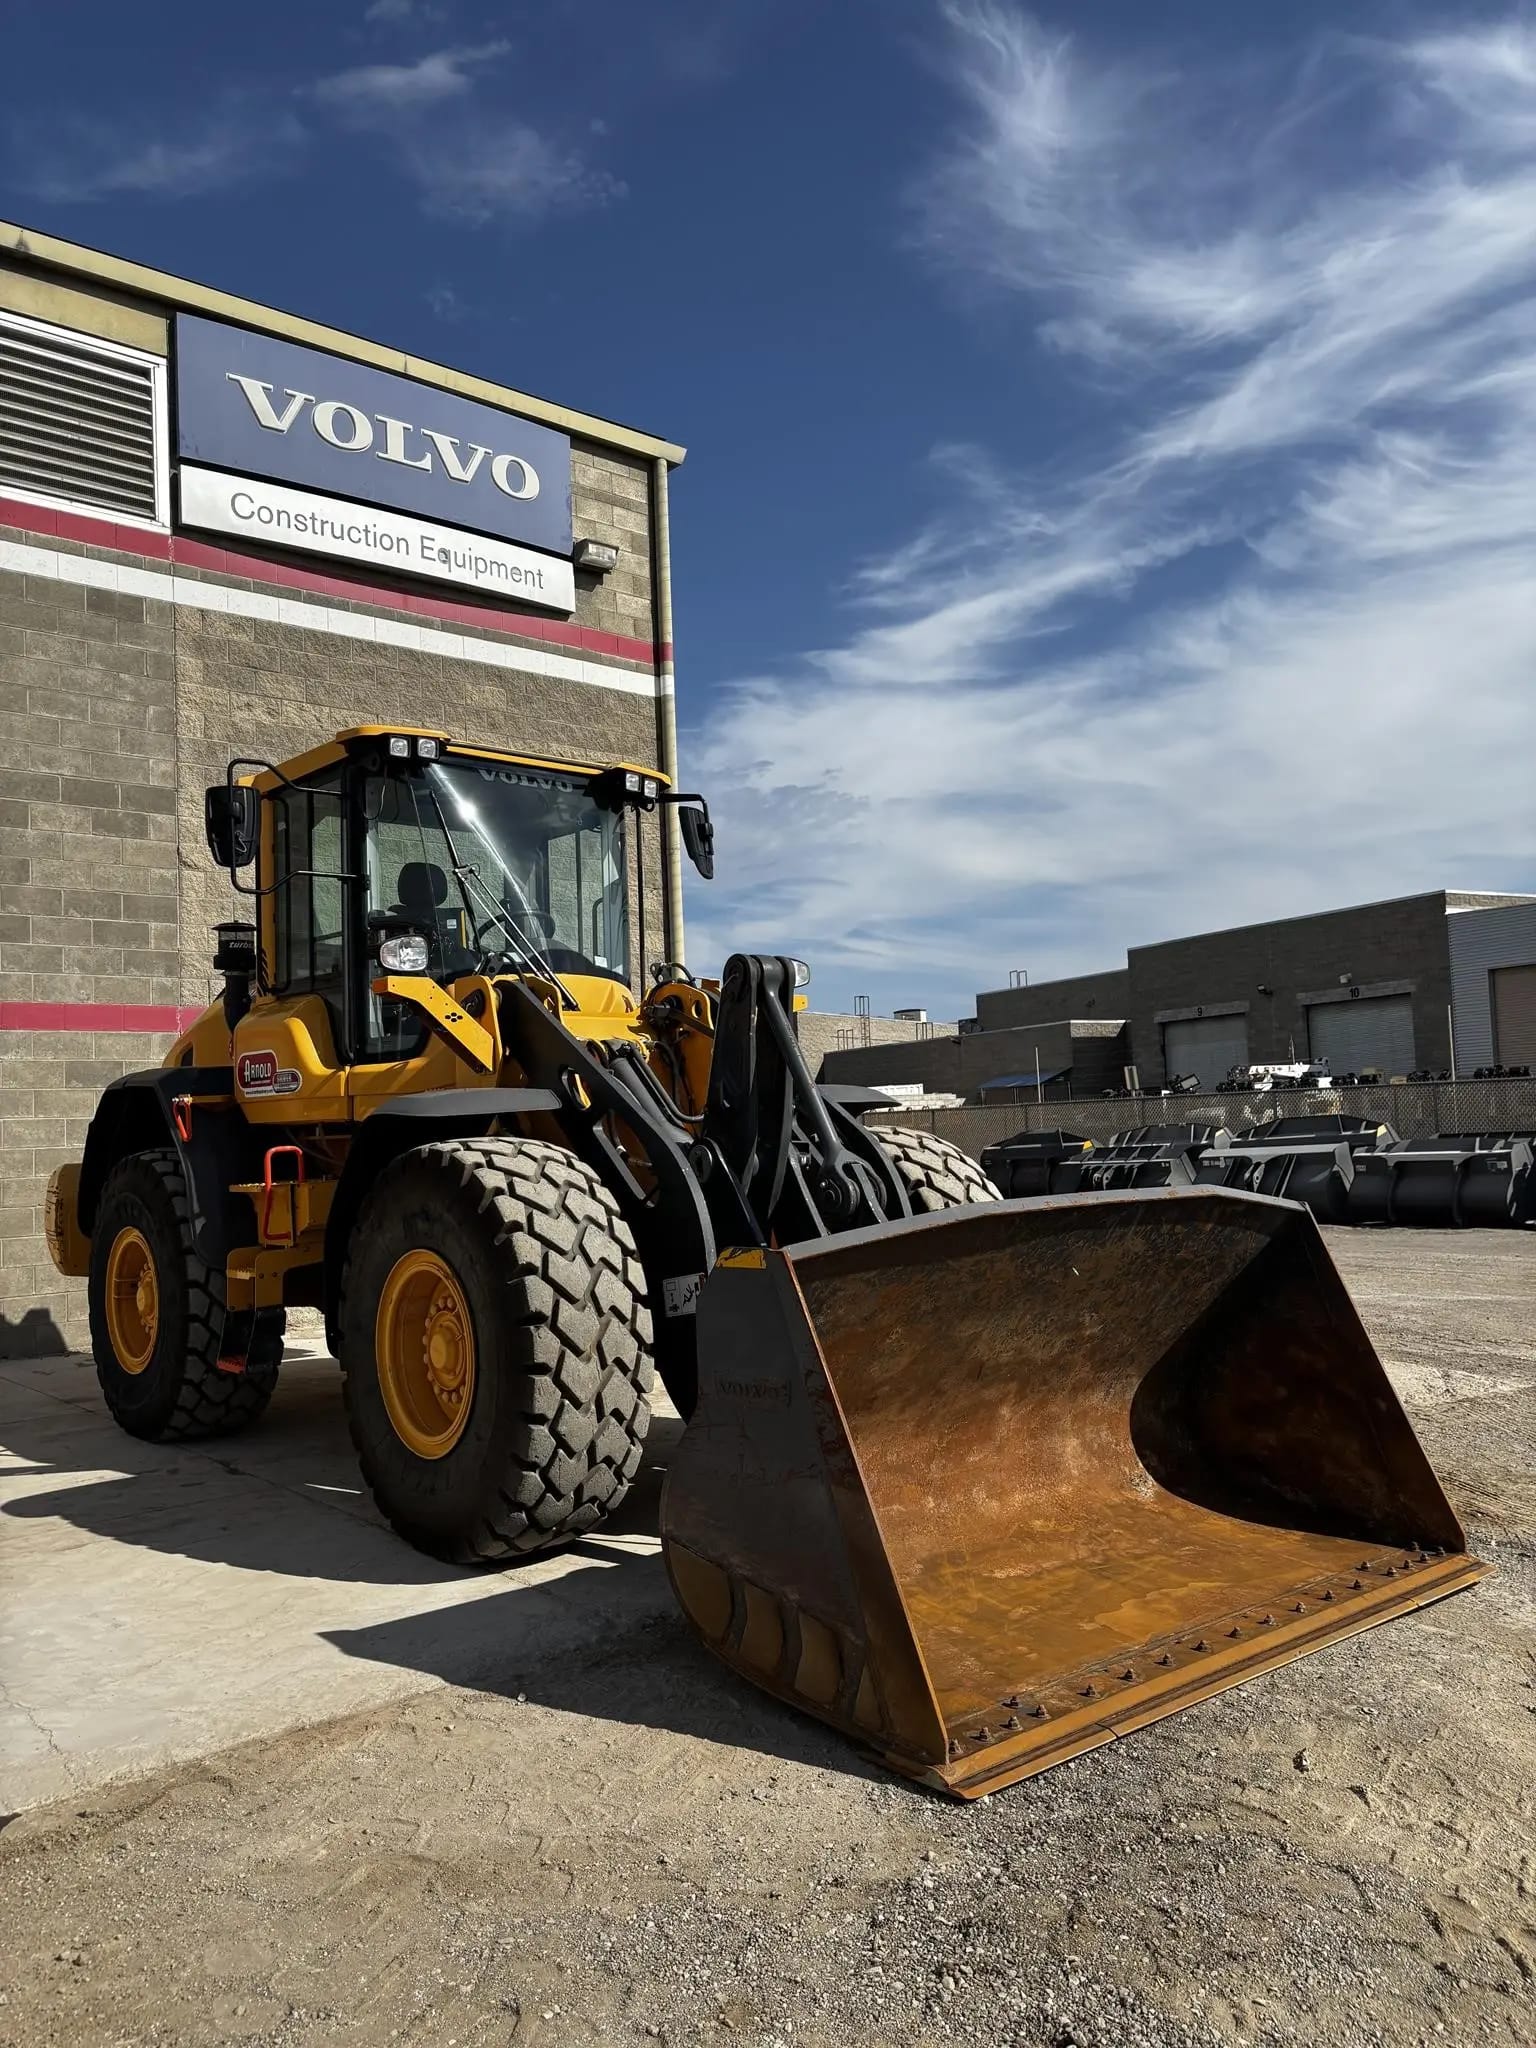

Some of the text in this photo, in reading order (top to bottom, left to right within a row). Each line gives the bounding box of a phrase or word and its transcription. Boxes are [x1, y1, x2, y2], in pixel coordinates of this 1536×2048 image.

[226, 372, 540, 501] VOLVO
[230, 492, 544, 590] Construction Equipment
[478, 769, 573, 793] VOLVO
[1349, 988, 1360, 998] 10
[1197, 1007, 1203, 1017] 9
[245, 1059, 272, 1082] ARNOLD
